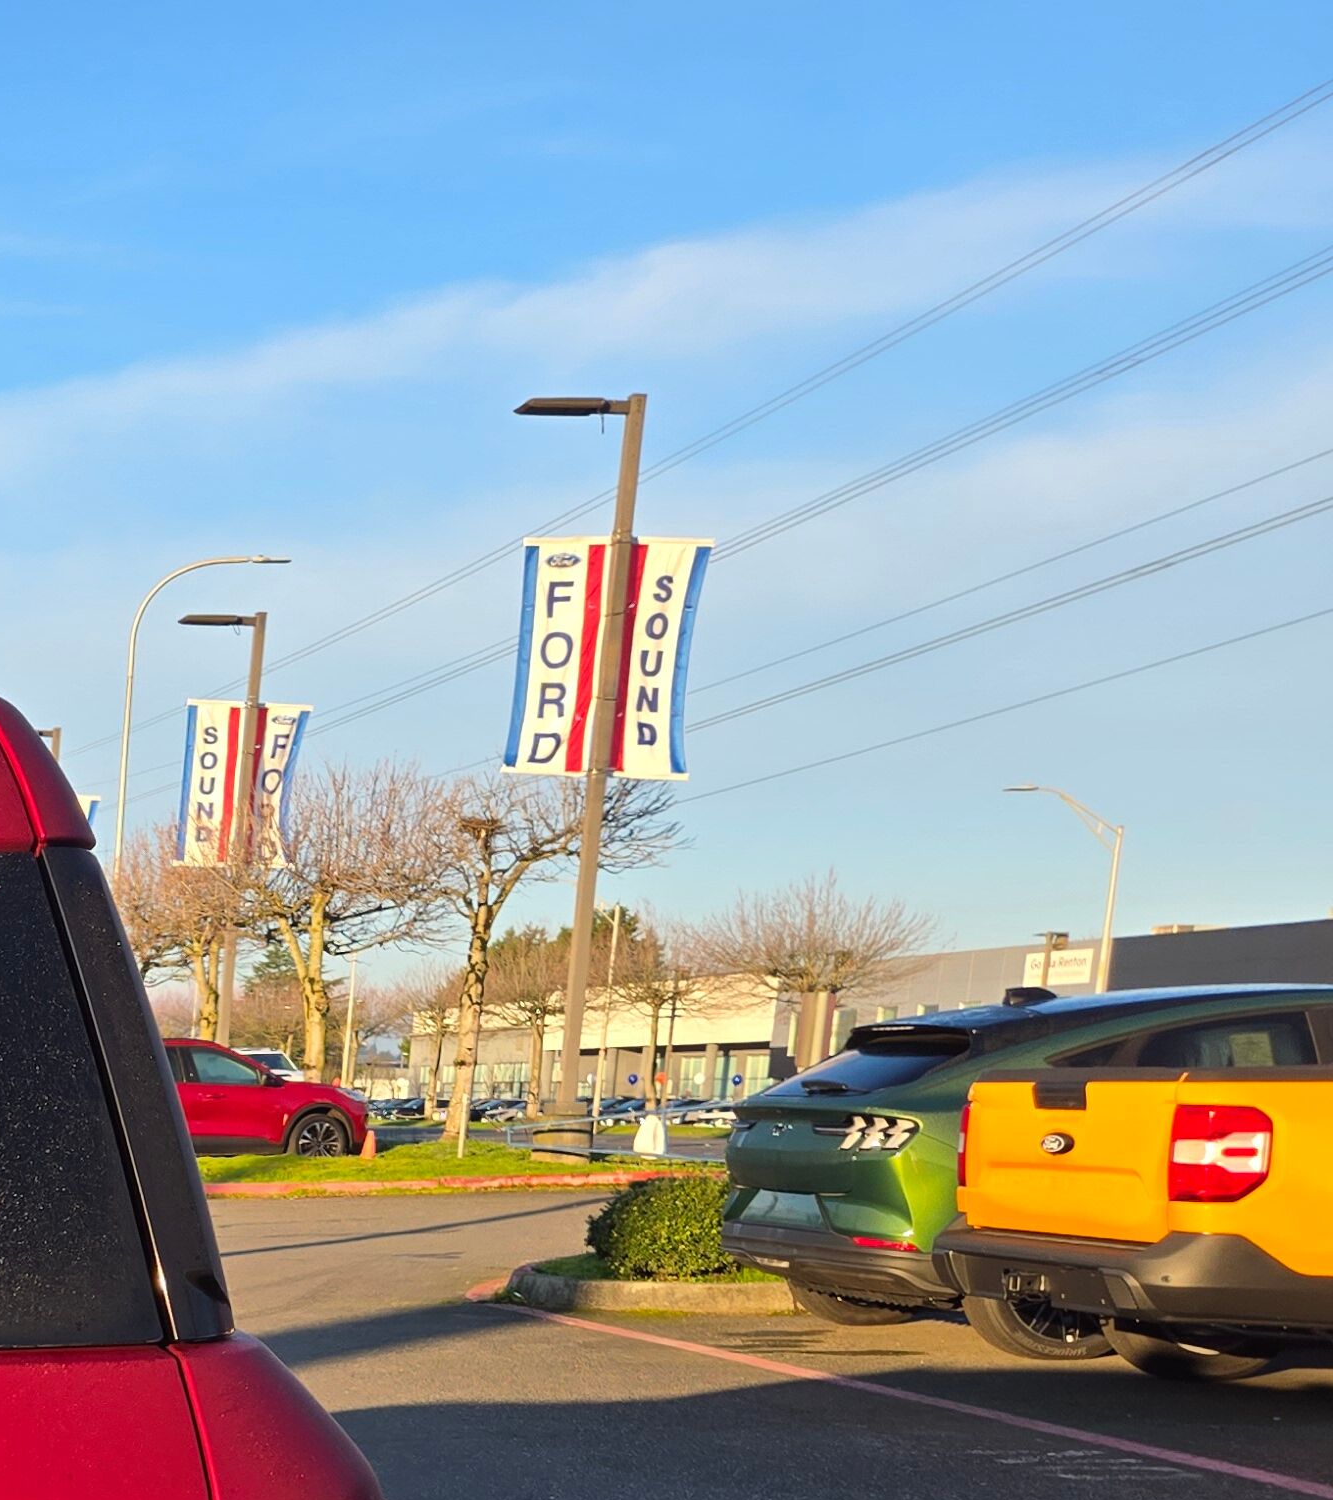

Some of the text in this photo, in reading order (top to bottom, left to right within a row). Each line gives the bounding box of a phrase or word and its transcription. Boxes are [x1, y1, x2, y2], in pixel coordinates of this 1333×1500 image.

[527, 581, 574, 764] FORD
[636, 575, 674, 747] SOUND
[195, 726, 219, 843] SOUND
